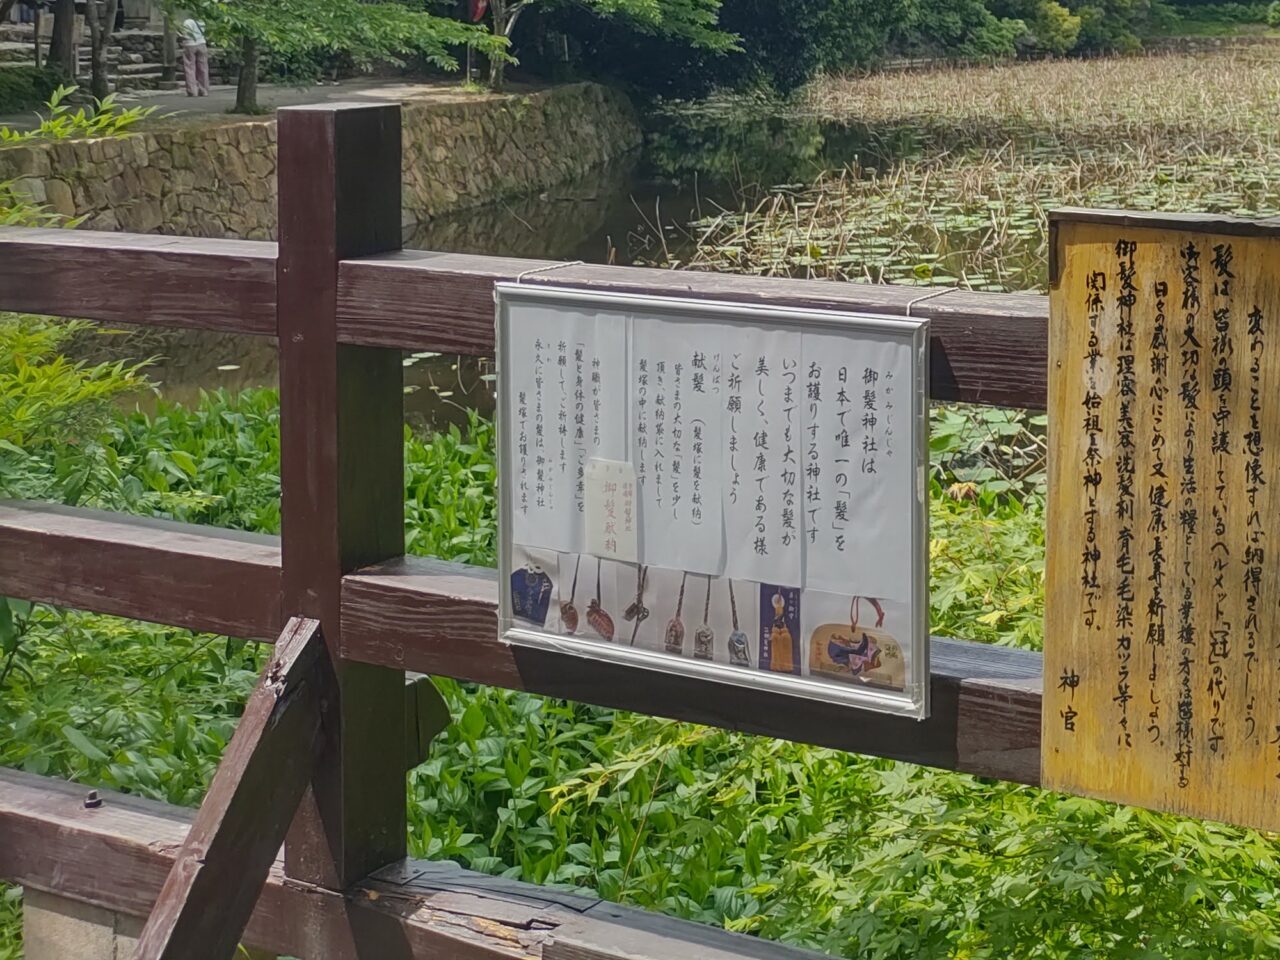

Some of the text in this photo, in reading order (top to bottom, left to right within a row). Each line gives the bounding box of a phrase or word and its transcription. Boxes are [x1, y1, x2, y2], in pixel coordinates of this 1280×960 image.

[692, 350, 708, 394] 献髪
[727, 352, 742, 505] ご祈願しましょう
[753, 355, 770, 556] 美しく、健康である様
[781, 358, 798, 546] いつまでも大切な髪が
[805, 361, 822, 544] お護りする神社です
[861, 367, 879, 474] 御髪神社は
[832, 366, 851, 551] 日本で唯一の「髪」を
[1058, 667, 1080, 732] 神官
